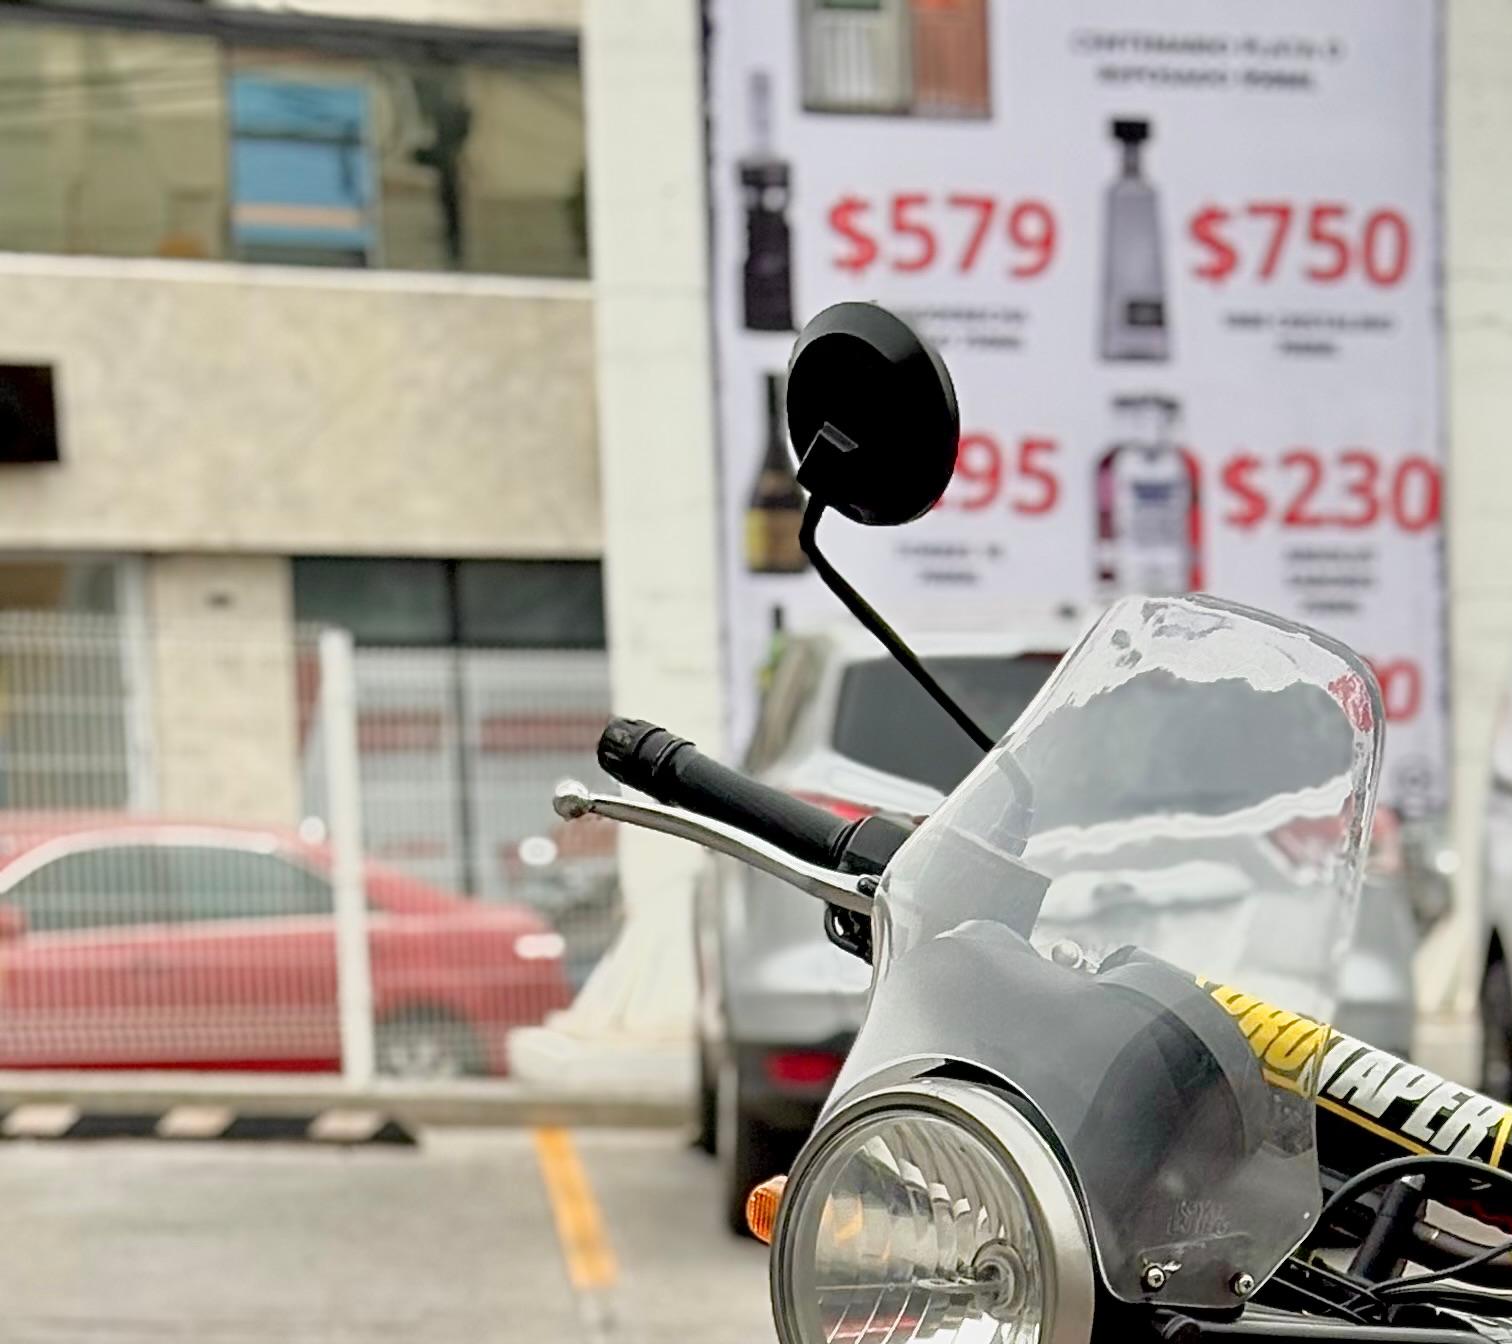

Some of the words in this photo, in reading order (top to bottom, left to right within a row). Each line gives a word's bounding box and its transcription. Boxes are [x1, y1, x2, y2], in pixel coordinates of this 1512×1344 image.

[828, 193, 1058, 280] $579
[1189, 202, 1410, 287] $750
[1221, 451, 1442, 533] $230
